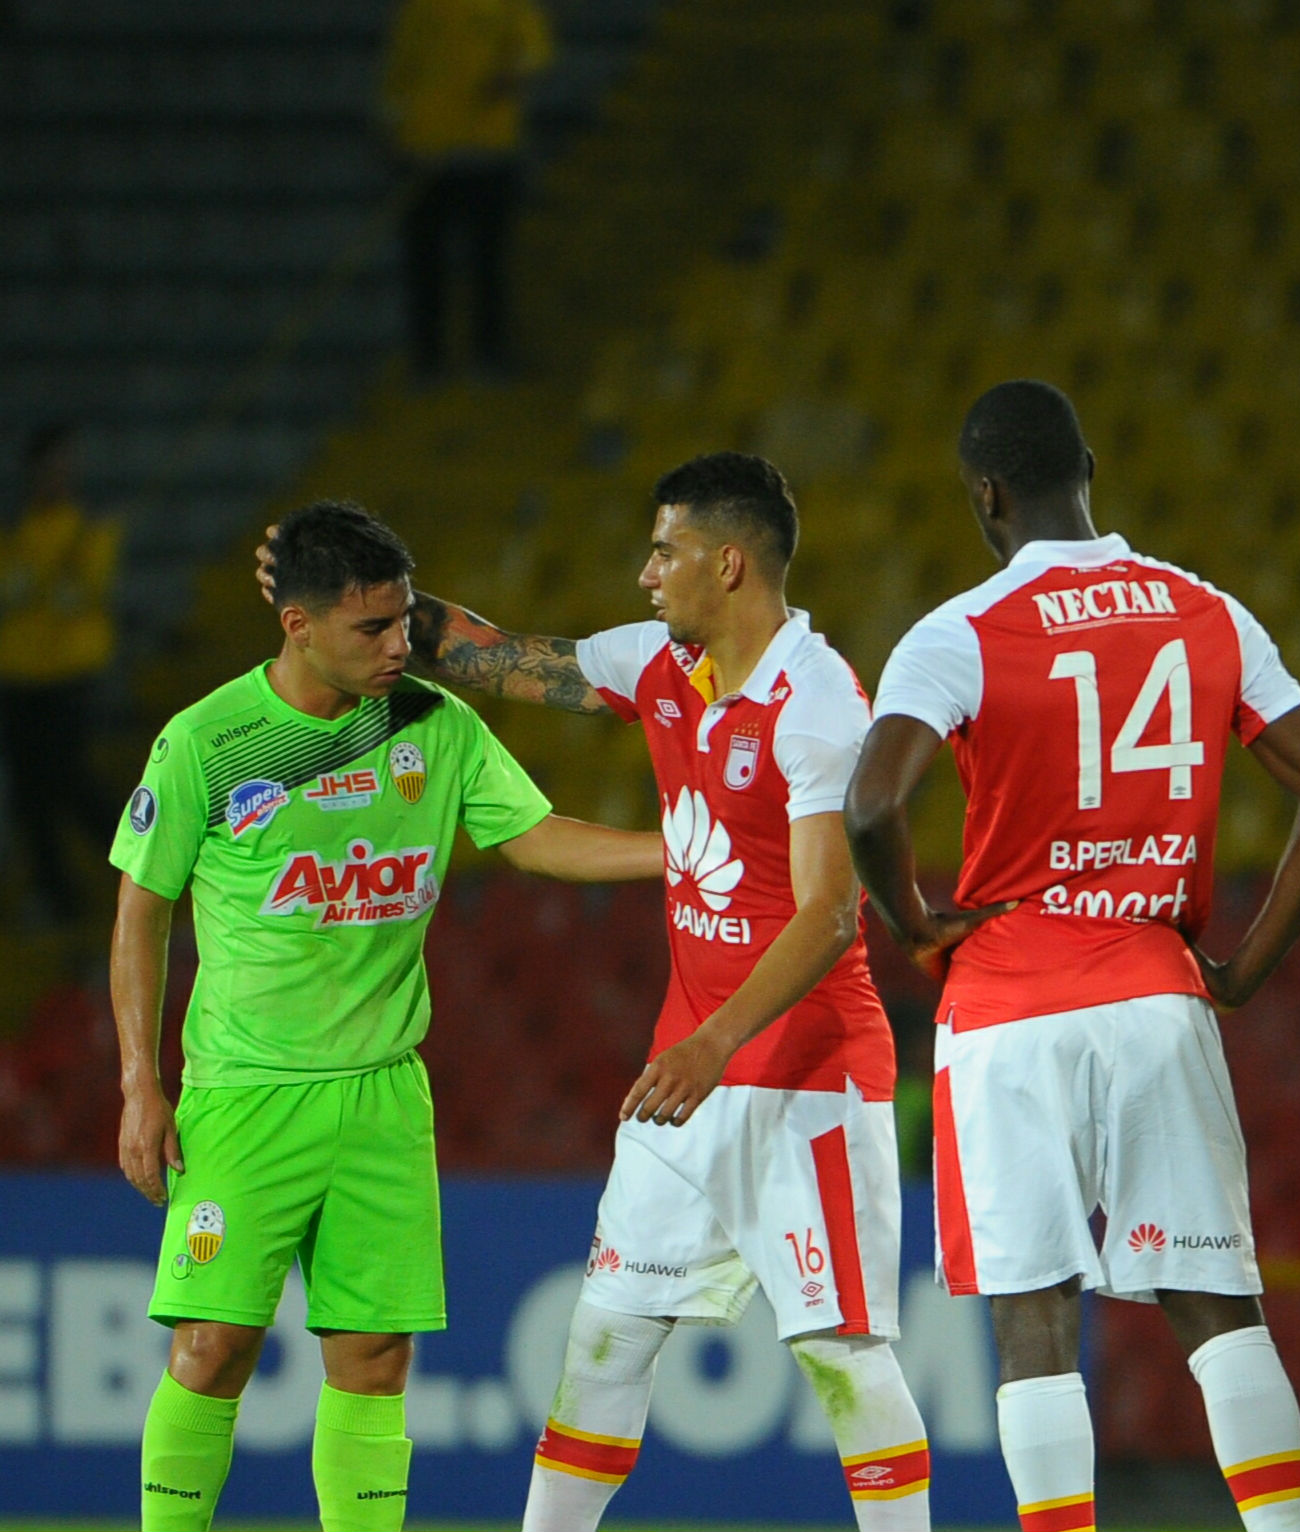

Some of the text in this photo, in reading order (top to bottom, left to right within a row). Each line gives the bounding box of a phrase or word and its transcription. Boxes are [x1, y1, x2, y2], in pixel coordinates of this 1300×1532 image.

[1032, 580, 1177, 628] NECTAR
[211, 716, 271, 748] uhlsport
[1048, 638, 1204, 810] 14
[307, 771, 377, 798] JHS
[226, 783, 285, 829] Super
[1050, 834, 1196, 871] B.PERLAZA
[271, 844, 428, 909] Avior
[321, 896, 405, 924] Airlines
[669, 897, 750, 944] AWEI
[785, 1227, 824, 1277] 16
[1173, 1234, 1242, 1249] HUAWE
[624, 1260, 688, 1278] HUAWEI
